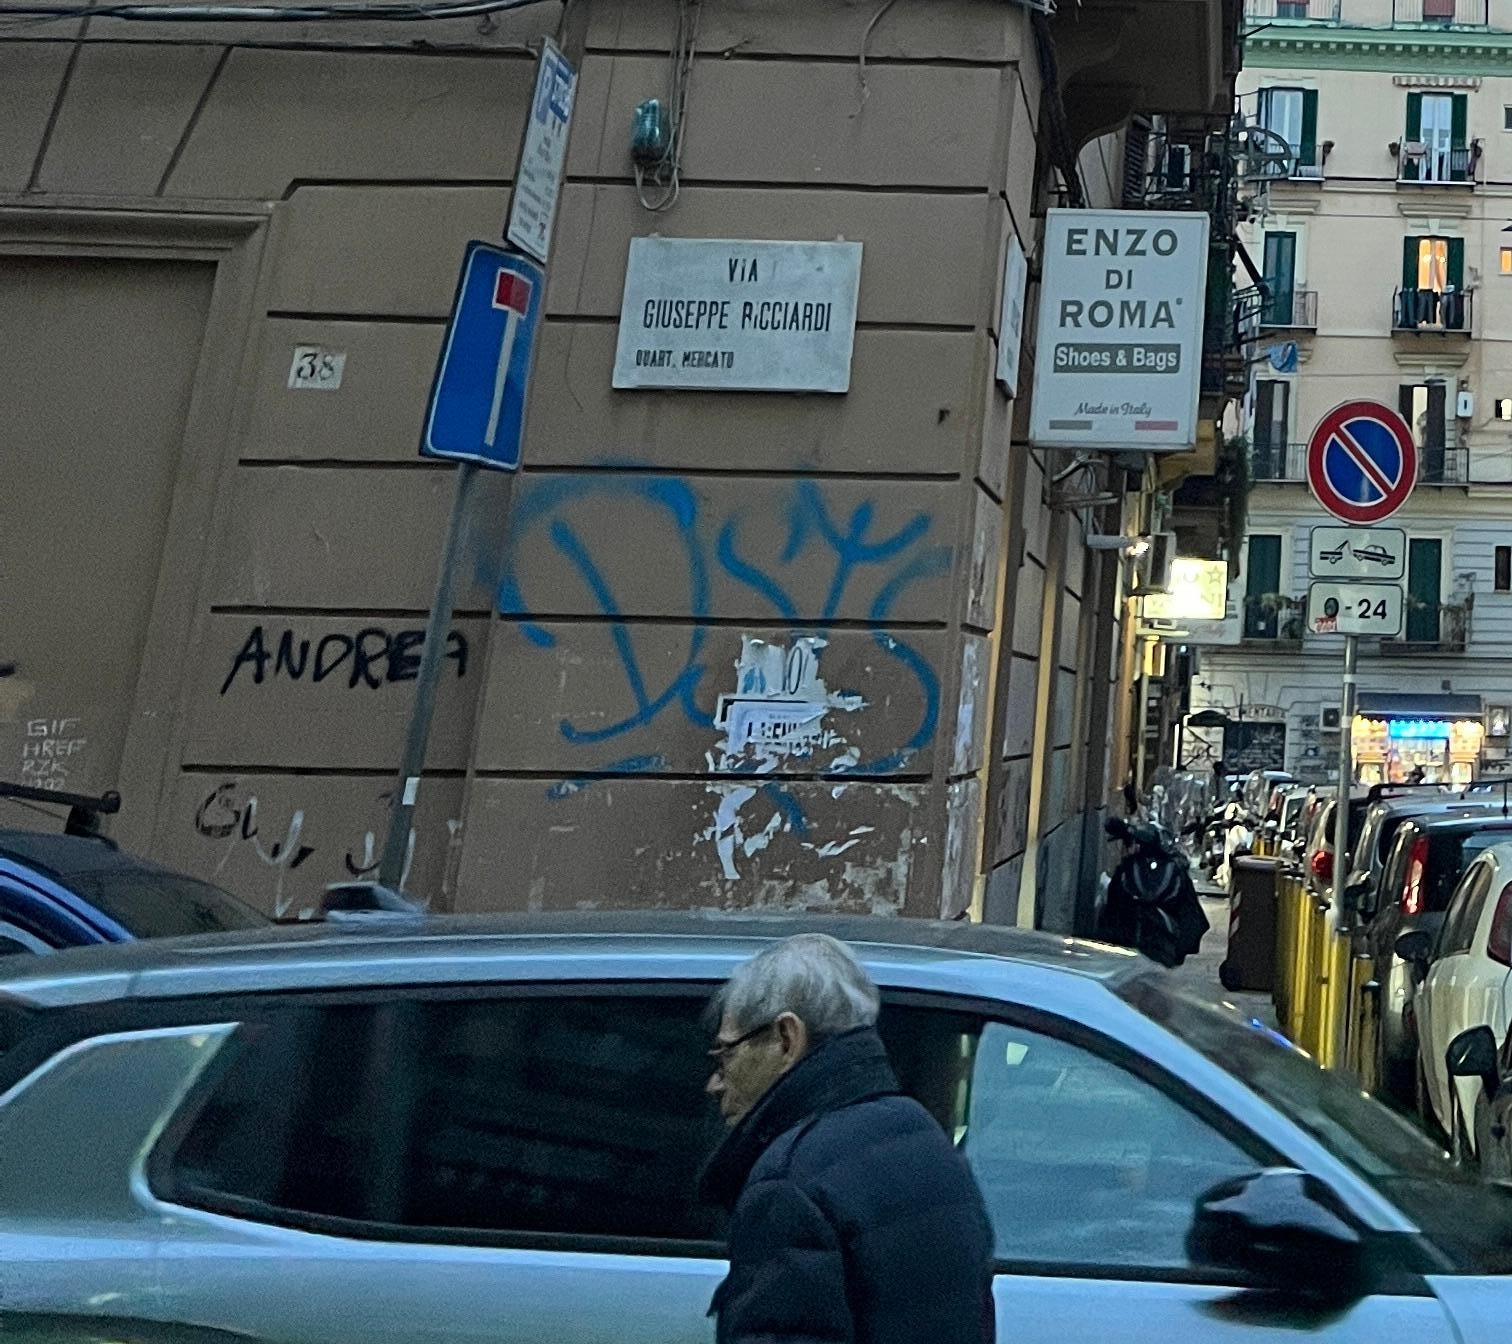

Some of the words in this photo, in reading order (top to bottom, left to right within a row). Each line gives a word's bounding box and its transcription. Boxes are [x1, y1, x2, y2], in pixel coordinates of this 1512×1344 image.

[1065, 227, 1178, 257] ENZO
[728, 258, 758, 283] VIA
[1105, 268, 1133, 290] DI
[643, 299, 731, 330] GIUSEPPE
[741, 301, 832, 332] RICCIARDI
[296, 353, 335, 379] 38
[1055, 346, 1111, 367] Shoes
[1115, 349, 1127, 367] &
[1133, 348, 1178, 372] Bags
[1074, 402, 1107, 416] Made
[1109, 406, 1120, 415] in
[1120, 403, 1153, 418] Italy
[1324, 597, 1339, 618] 0
[1358, 598, 1387, 620] 24
[220, 625, 469, 696] ANDREA
